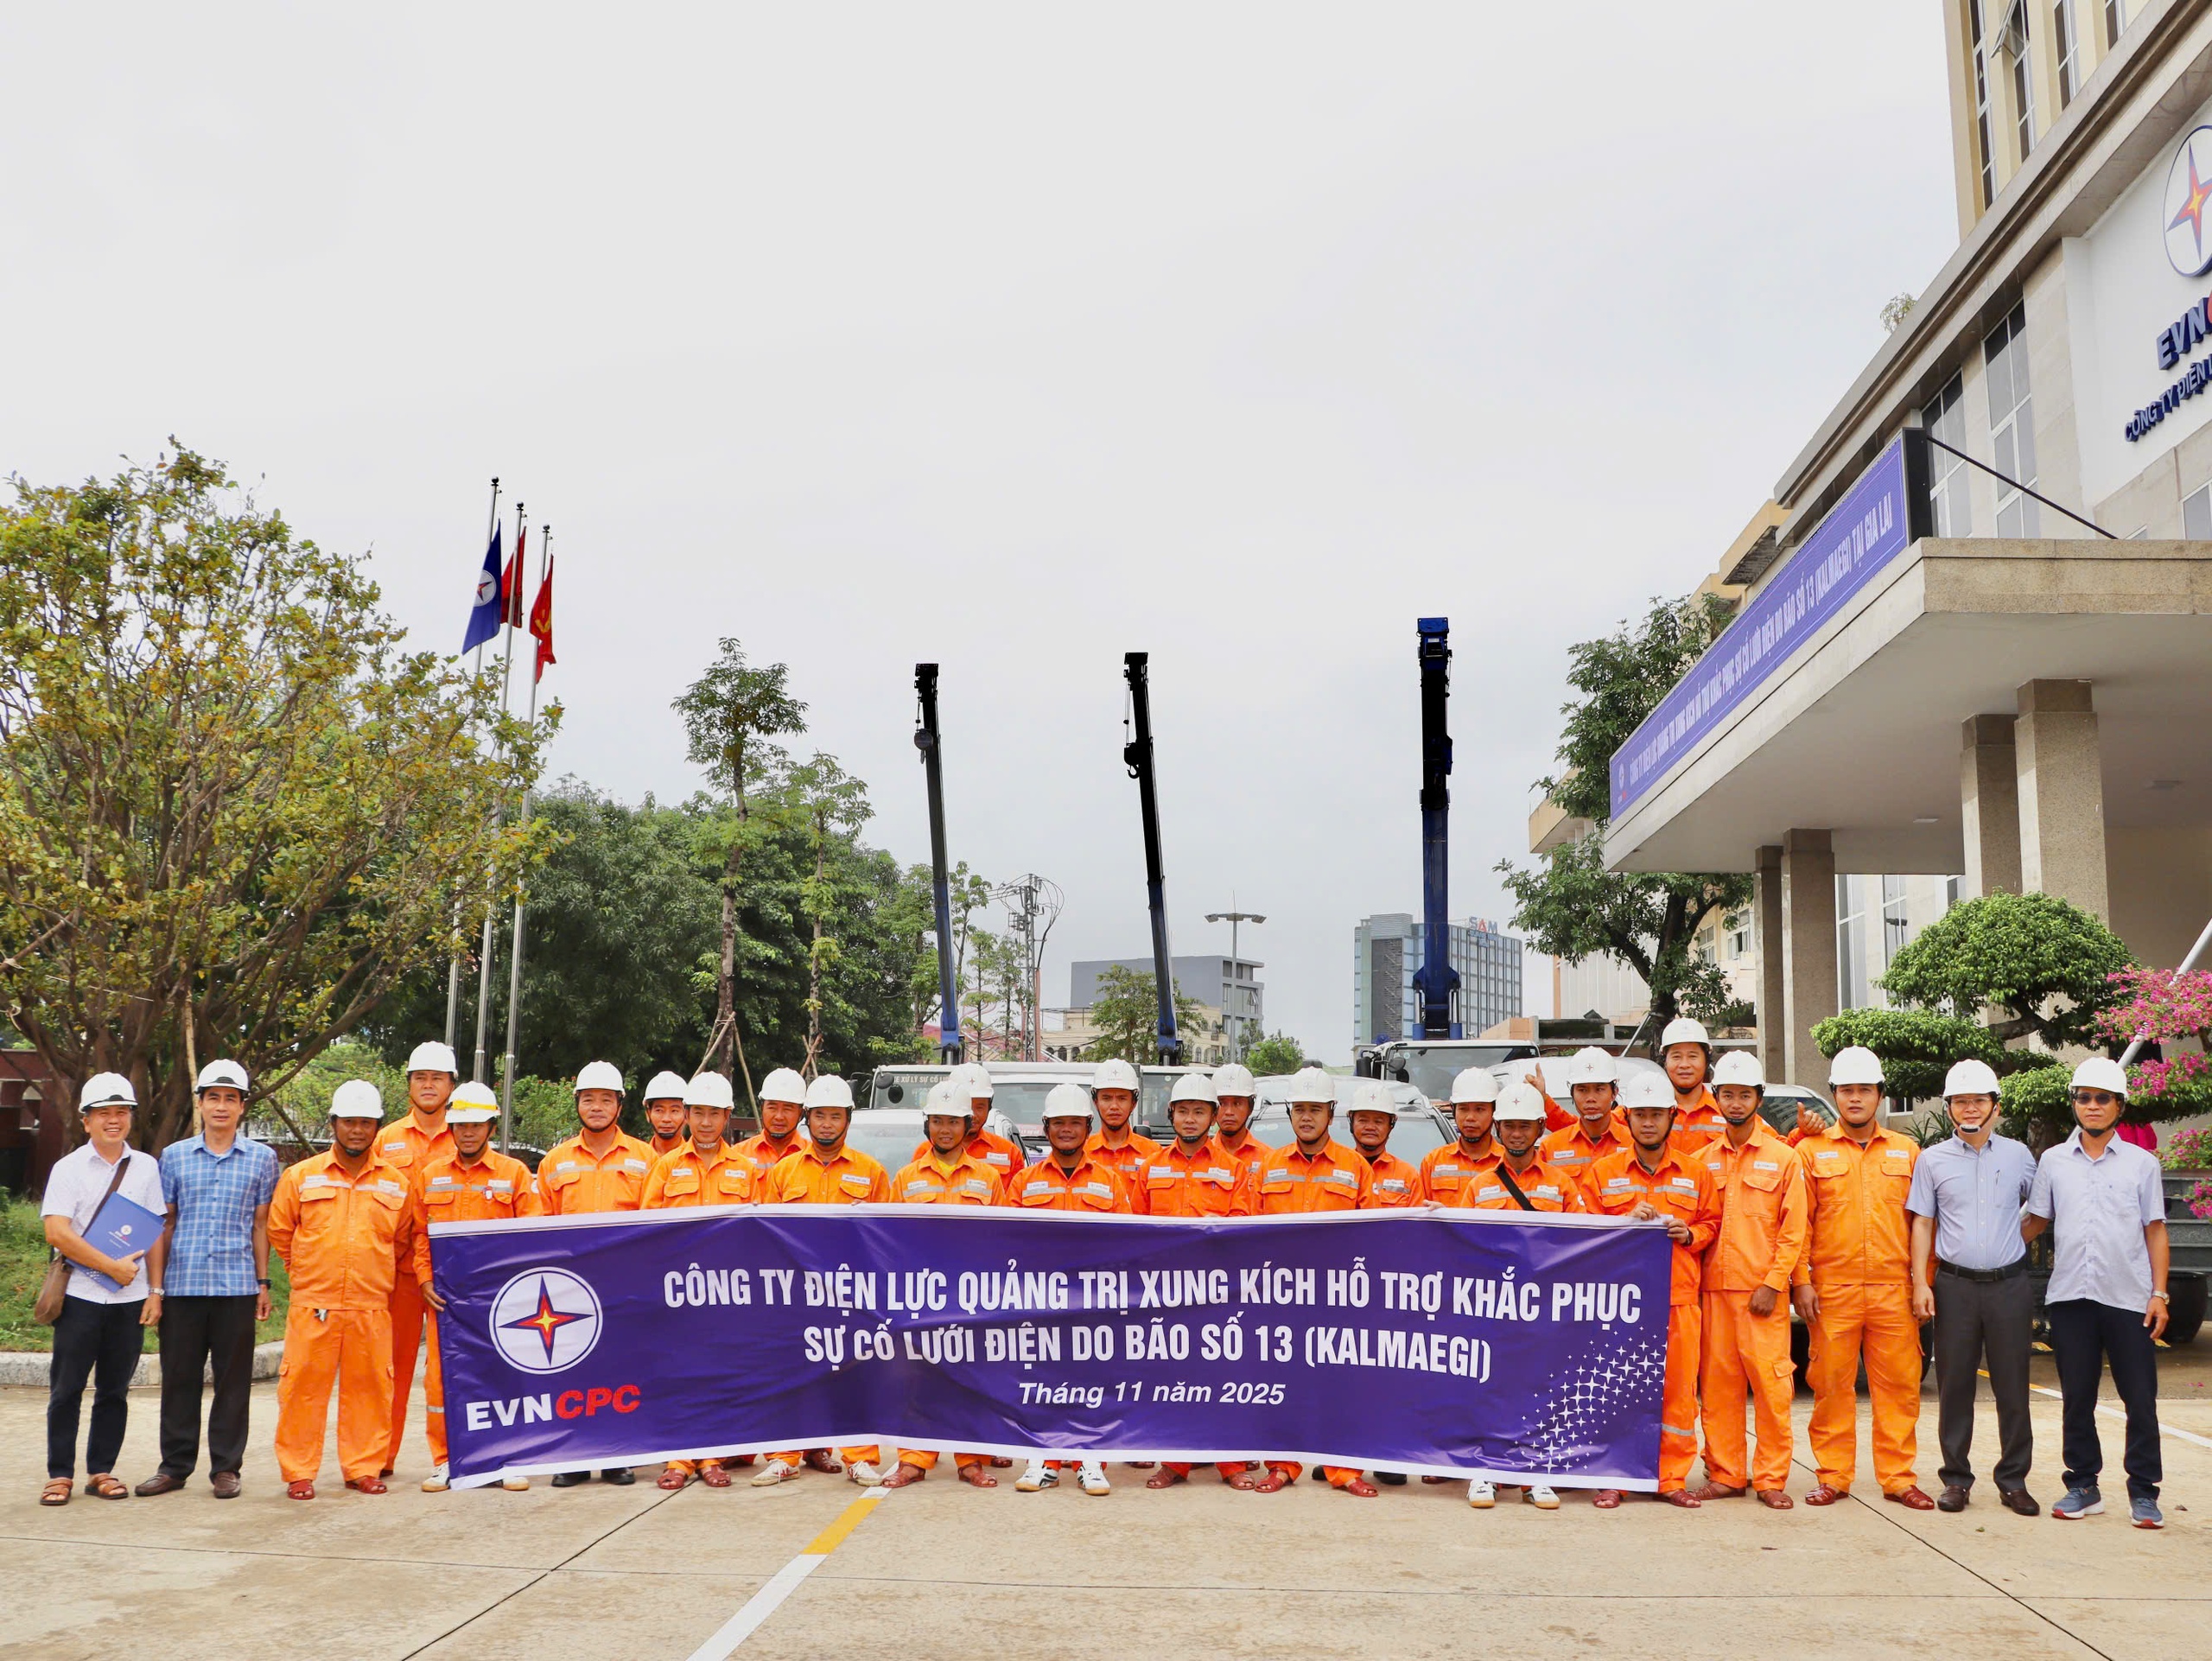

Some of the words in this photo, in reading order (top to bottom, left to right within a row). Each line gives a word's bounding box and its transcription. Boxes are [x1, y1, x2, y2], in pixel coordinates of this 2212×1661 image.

[2156, 290, 2212, 370] EVN
[2125, 402, 2163, 442] CÔNG
[2159, 385, 2179, 413] TY
[2177, 362, 2208, 399] ĐIỆN
[1805, 575, 1815, 611] 13
[1852, 520, 1865, 567] TẠI
[1864, 506, 1879, 551] GIA
[1878, 492, 1893, 538] LAI
[1470, 916, 1498, 934] SAM
[664, 1263, 752, 1308] CÔNG
[759, 1269, 795, 1306] TY
[804, 1263, 877, 1317] ĐIỆN
[886, 1268, 948, 1319] LỰC
[958, 1258, 1069, 1315] QUẢNG
[1078, 1270, 1128, 1315] TRỊ
[1139, 1269, 1229, 1308] XUNG
[1240, 1261, 1316, 1306] KÍCH
[1327, 1256, 1370, 1308] HỖ
[1380, 1270, 1443, 1321] TRỢ
[1452, 1265, 1541, 1322] KHẮC
[1551, 1282, 1642, 1331] PHỤC
[804, 1324, 846, 1371] SỰ
[854, 1318, 895, 1361] CỐ
[903, 1324, 975, 1365] LƯỚI
[984, 1321, 1061, 1370] ĐIỆN
[1071, 1325, 1115, 1361] DO
[1125, 1317, 1190, 1361] BÃO
[1200, 1310, 1244, 1361] SỐ
[1255, 1325, 1294, 1363] 13
[1305, 1326, 1491, 1384] (KALMAEGI)
[466, 1384, 641, 1431] EVNCPC
[1019, 1382, 1105, 1409] Tháng
[1115, 1381, 1143, 1403] 11
[1152, 1381, 1212, 1403] năm
[1218, 1382, 1287, 1405] 2025
